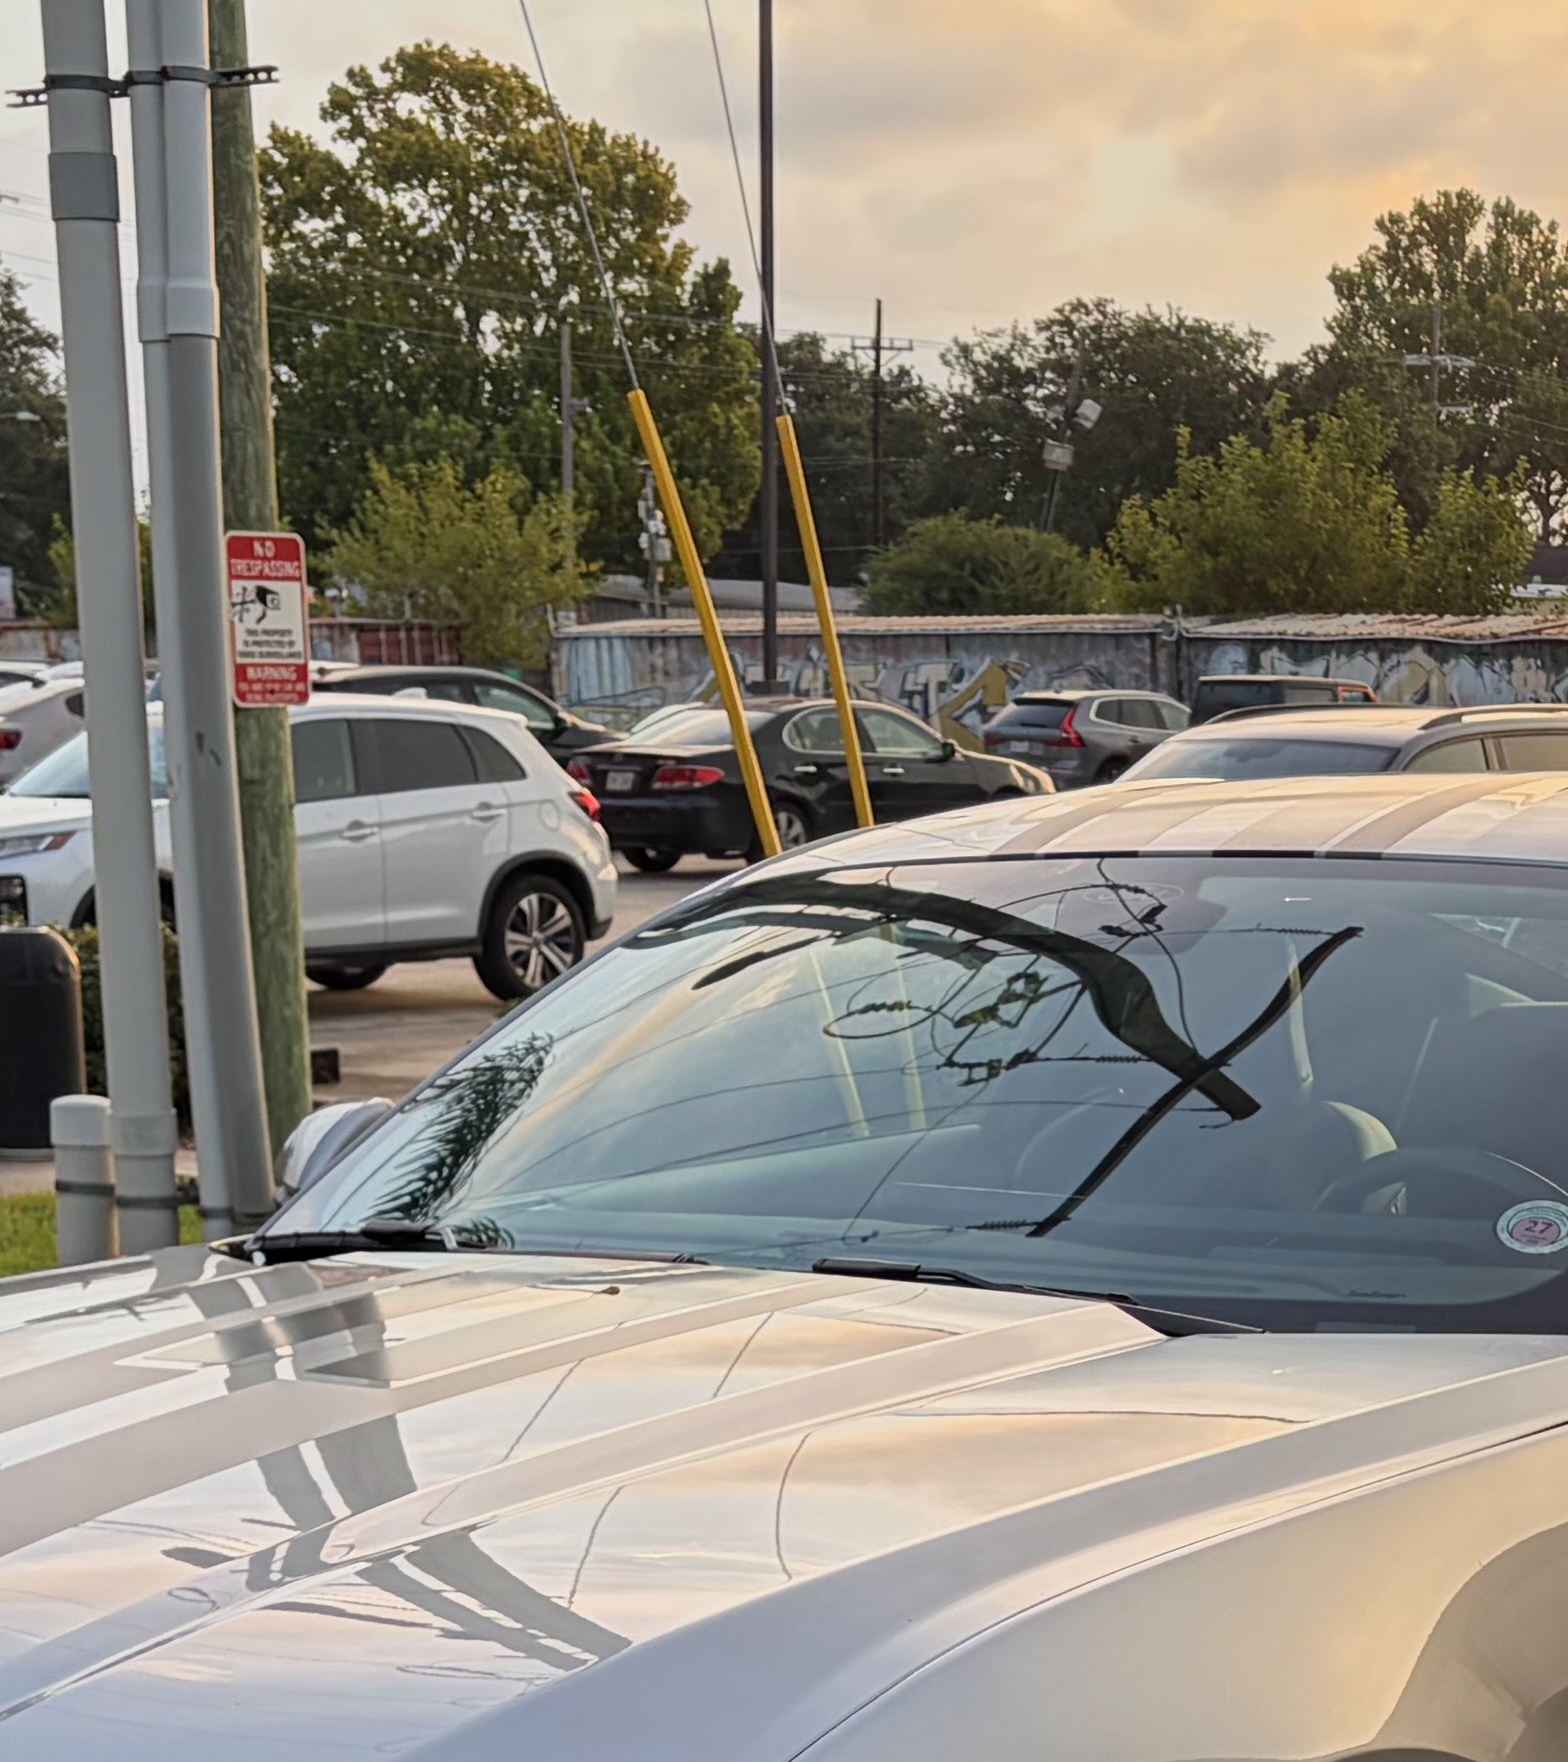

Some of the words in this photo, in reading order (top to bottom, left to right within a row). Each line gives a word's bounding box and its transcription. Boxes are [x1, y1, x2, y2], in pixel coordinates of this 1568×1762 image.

[253, 540, 276, 558] NO
[230, 559, 301, 578] TRESPASSING
[246, 666, 298, 681] WARNING
[1524, 1220, 1554, 1234] 27
